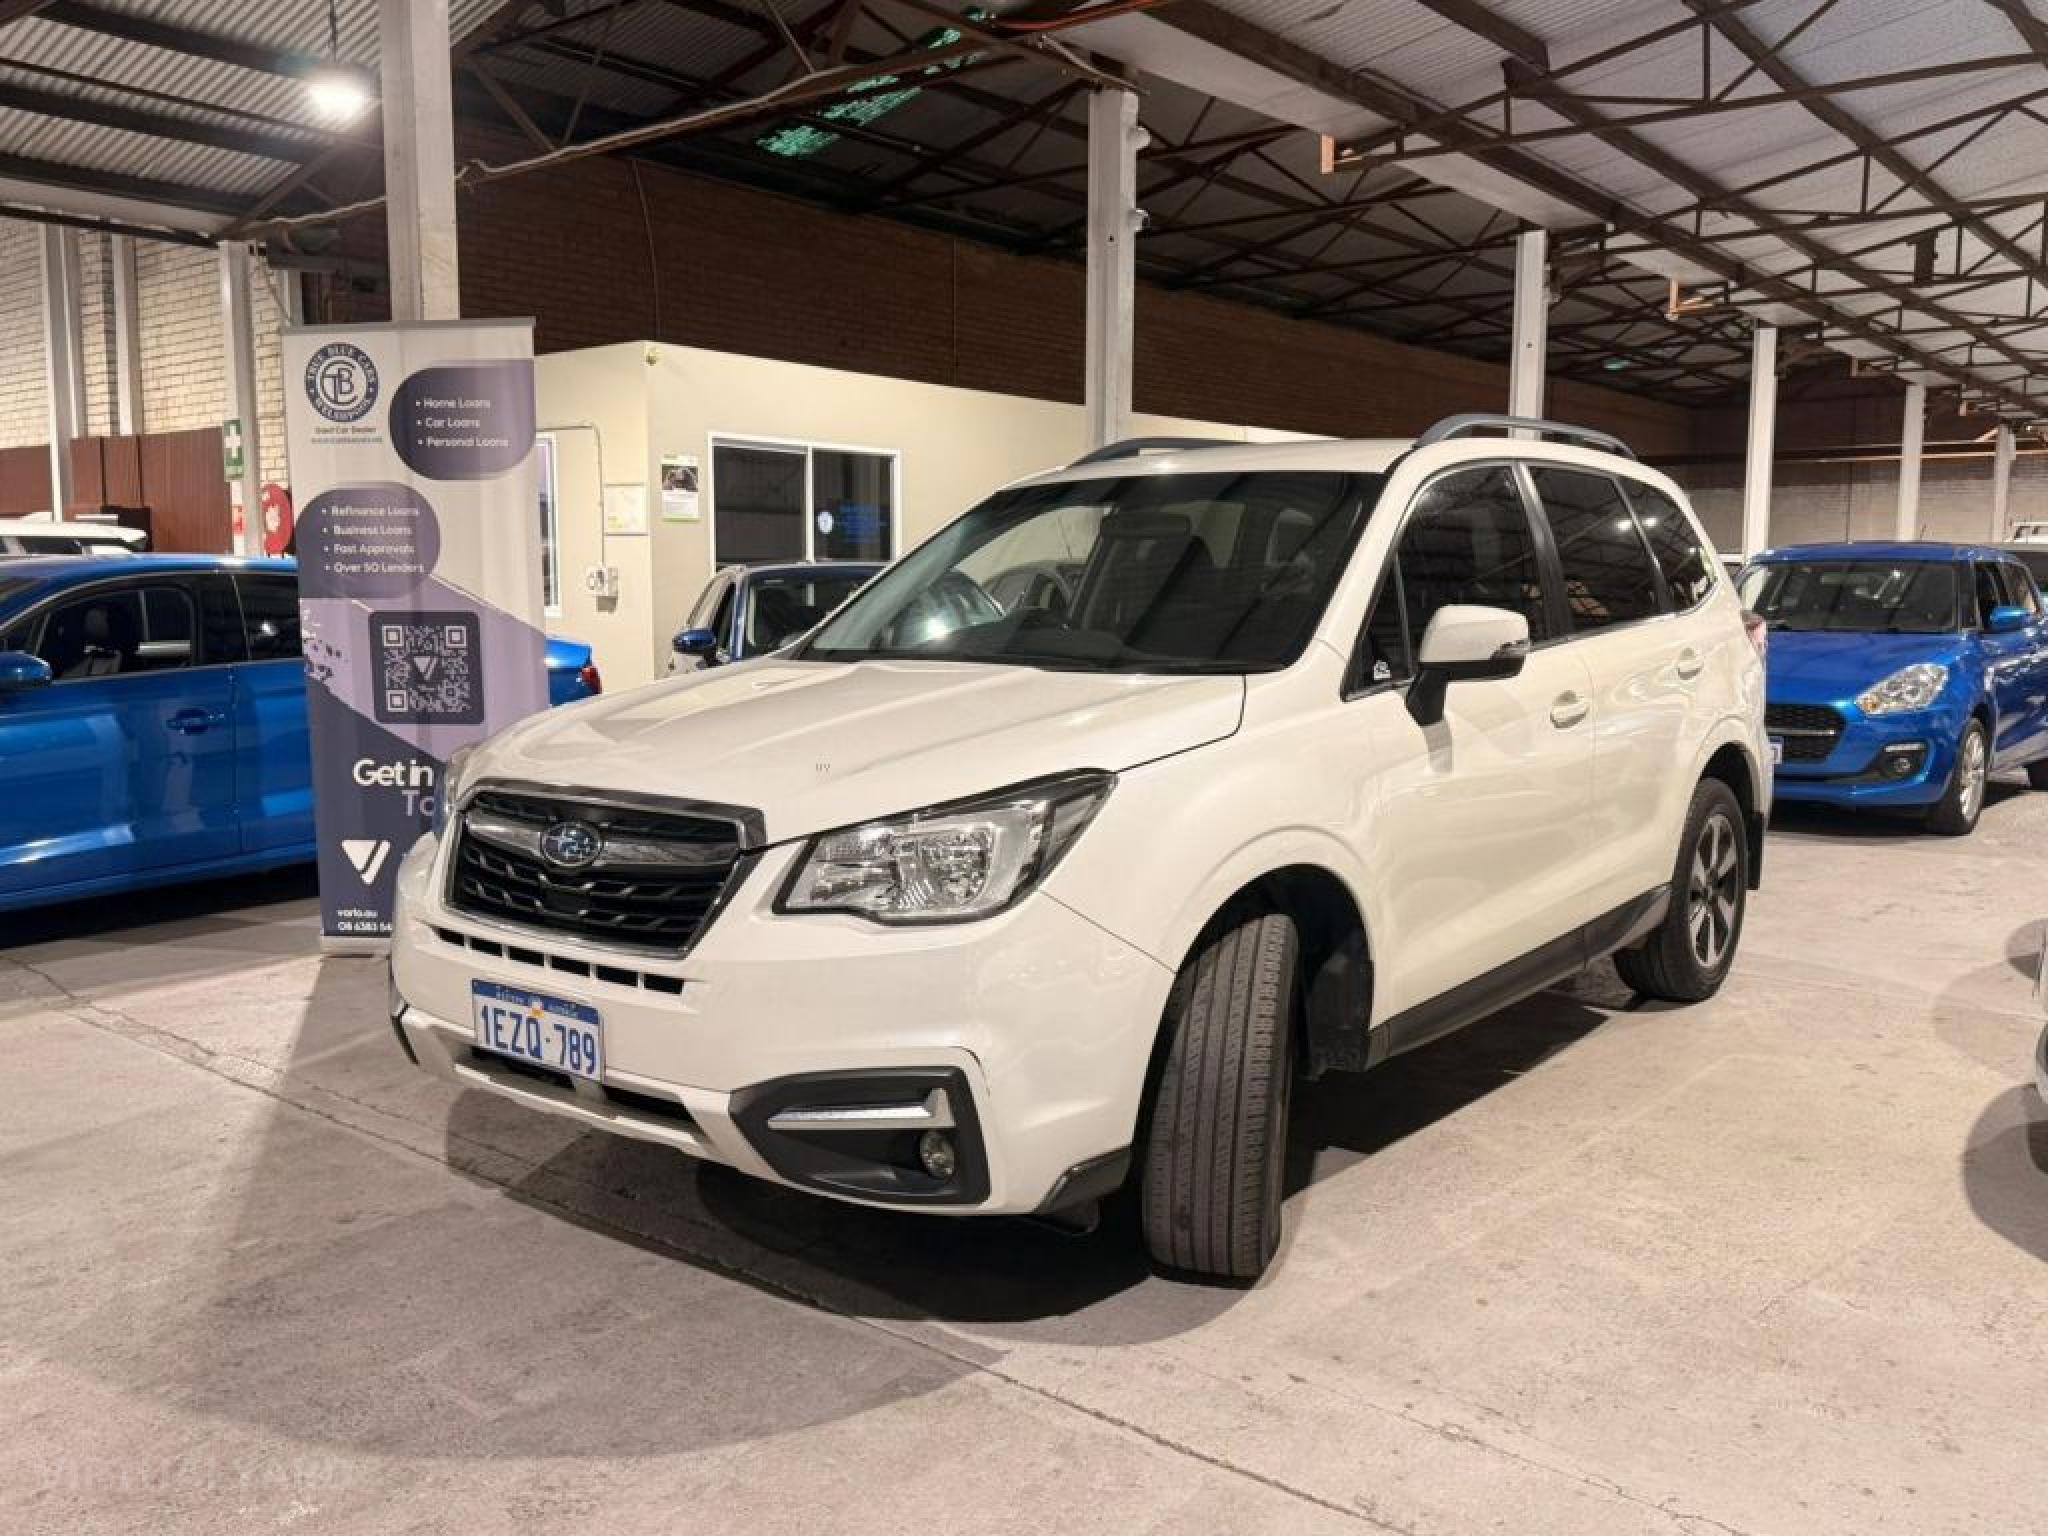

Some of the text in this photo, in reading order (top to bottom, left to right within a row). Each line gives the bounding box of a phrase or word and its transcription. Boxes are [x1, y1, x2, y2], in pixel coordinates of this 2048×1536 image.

[424, 396, 491, 409] Home Loans
[425, 416, 481, 429] Car Loans
[426, 435, 510, 448] Personal Loans
[331, 504, 420, 517] Refinance Loans
[333, 525, 413, 536] Business Loans
[333, 542, 416, 557] Fast Approvals
[333, 561, 361, 575] Over
[381, 561, 424, 574] Lenders
[353, 758, 434, 787] Get in
